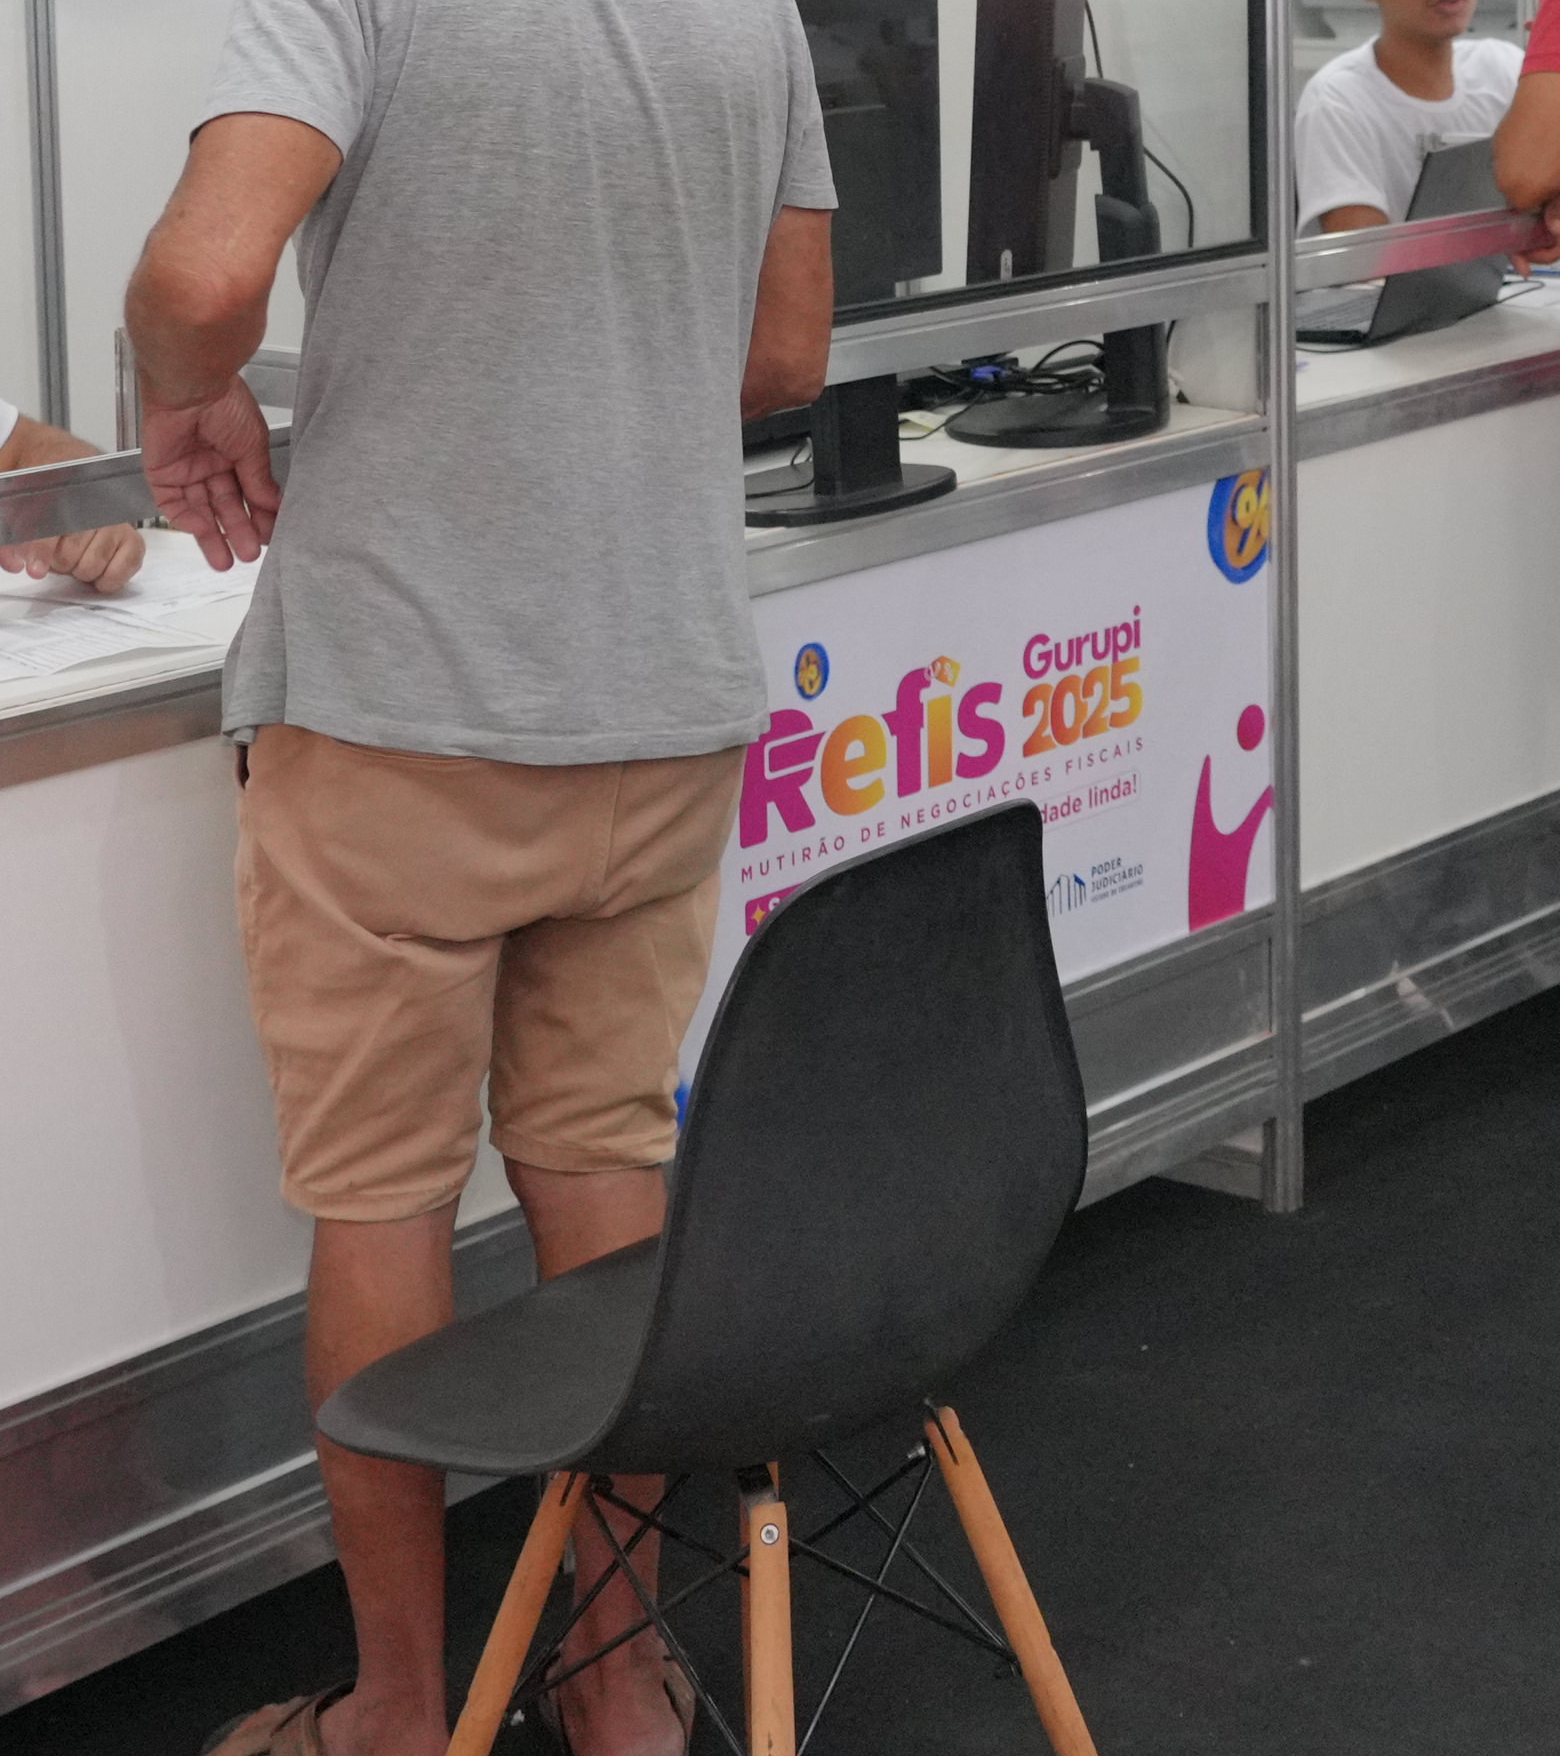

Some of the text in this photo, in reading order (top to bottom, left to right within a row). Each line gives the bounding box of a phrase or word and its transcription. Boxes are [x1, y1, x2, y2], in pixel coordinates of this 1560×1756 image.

[1022, 605, 1142, 681] Gurupi
[739, 654, 1144, 850] Refis 2025
[741, 737, 1144, 883] MUTIRÃO DE NEGOCIAÇÕES FISCAIS
[1089, 773, 1138, 809] linda!
[1091, 856, 1122, 879] PODER
